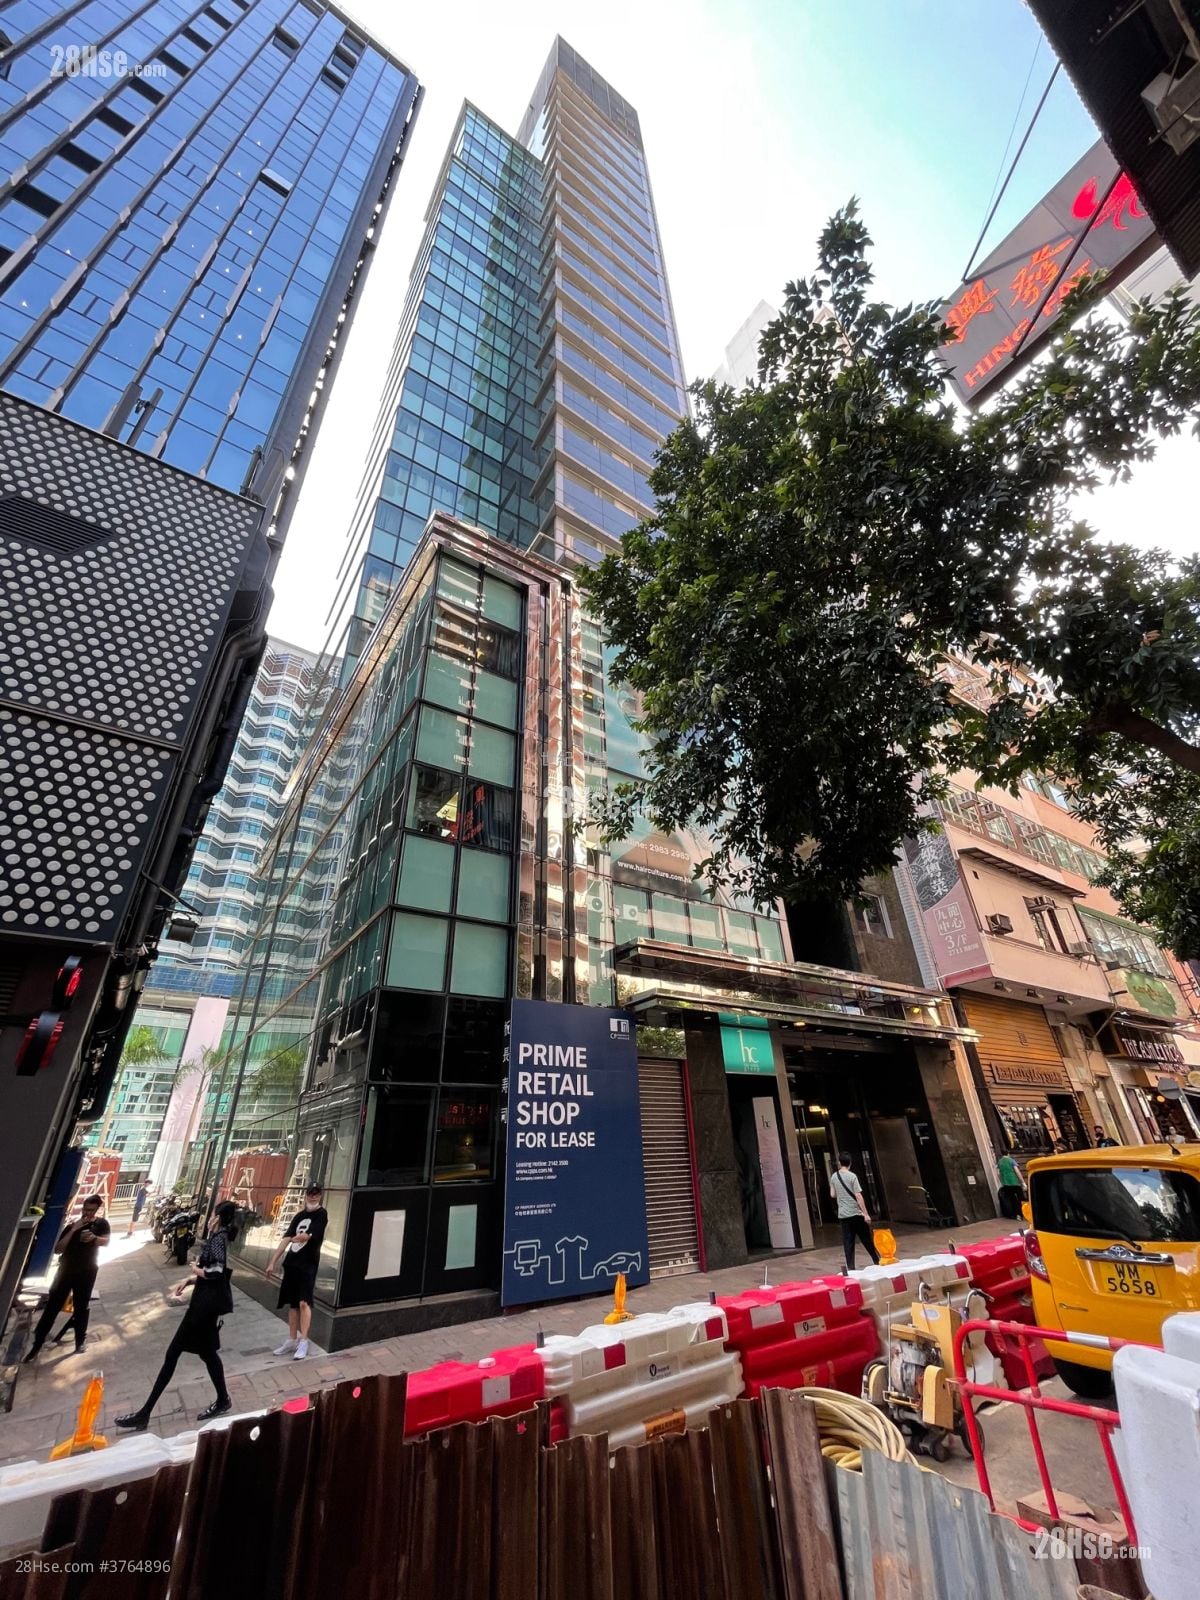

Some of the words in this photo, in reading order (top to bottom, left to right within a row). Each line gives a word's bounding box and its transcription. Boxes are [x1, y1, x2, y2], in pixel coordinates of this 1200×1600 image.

[518, 1043, 588, 1068] PRIME
[517, 1071, 594, 1096] RETAIL
[516, 1101, 580, 1126] SHOP
[516, 1132, 547, 1149] FOR
[551, 1131, 596, 1148] LEASE
[1114, 1263, 1140, 1279] WM
[1107, 1277, 1156, 1296] 5658
